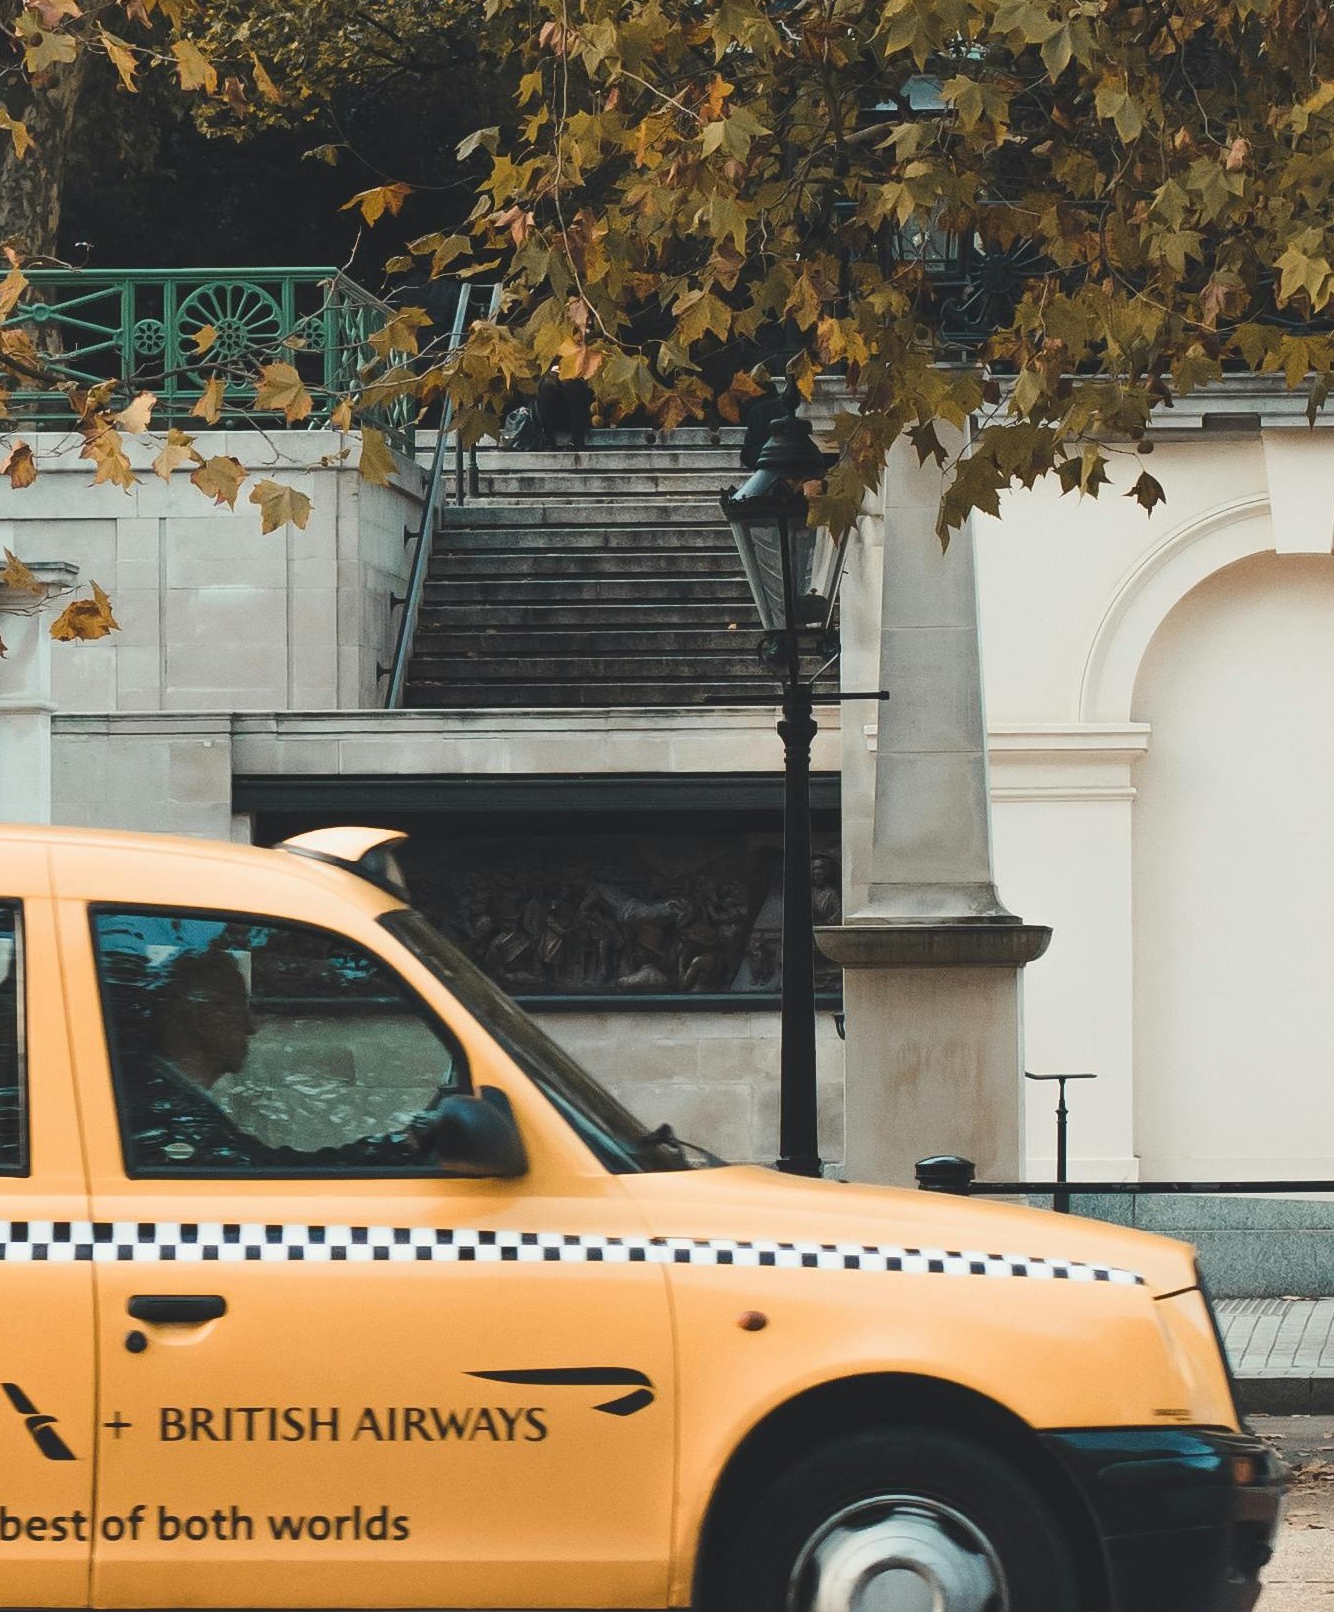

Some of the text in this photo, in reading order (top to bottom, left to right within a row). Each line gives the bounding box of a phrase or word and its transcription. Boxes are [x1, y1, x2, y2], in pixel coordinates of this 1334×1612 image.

[159, 1407, 339, 1442] BRITISH
[352, 1407, 548, 1442] AIRWAYS
[0, 1505, 89, 1542] best
[101, 1504, 147, 1542] of
[158, 1505, 253, 1541] both
[267, 1505, 410, 1541] worlds
